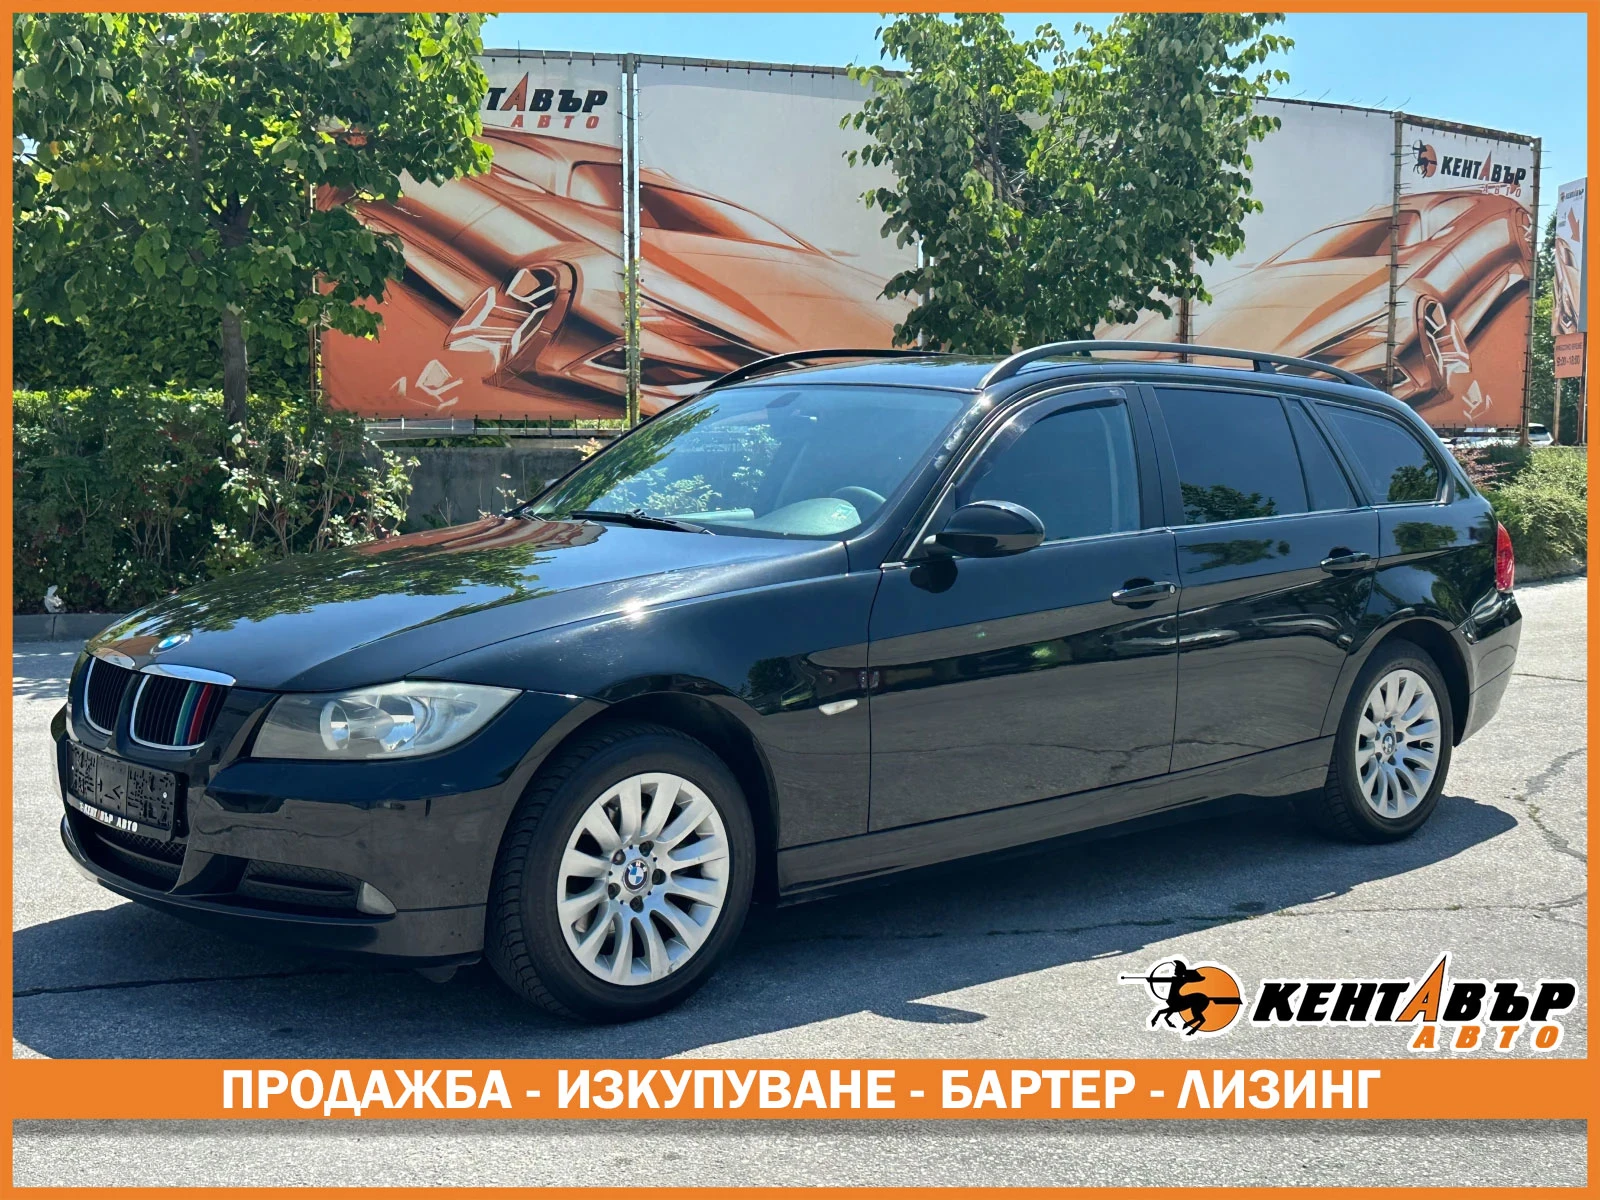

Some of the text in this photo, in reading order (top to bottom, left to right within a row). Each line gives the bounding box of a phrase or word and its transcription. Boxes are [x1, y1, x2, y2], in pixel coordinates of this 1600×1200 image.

[479, 71, 608, 113] ТАВЪР
[511, 114, 600, 129] АВТО
[1440, 150, 1527, 185] КЕНТАВЪР
[1482, 184, 1522, 198] АВТО
[116, 817, 138, 833] АВТО
